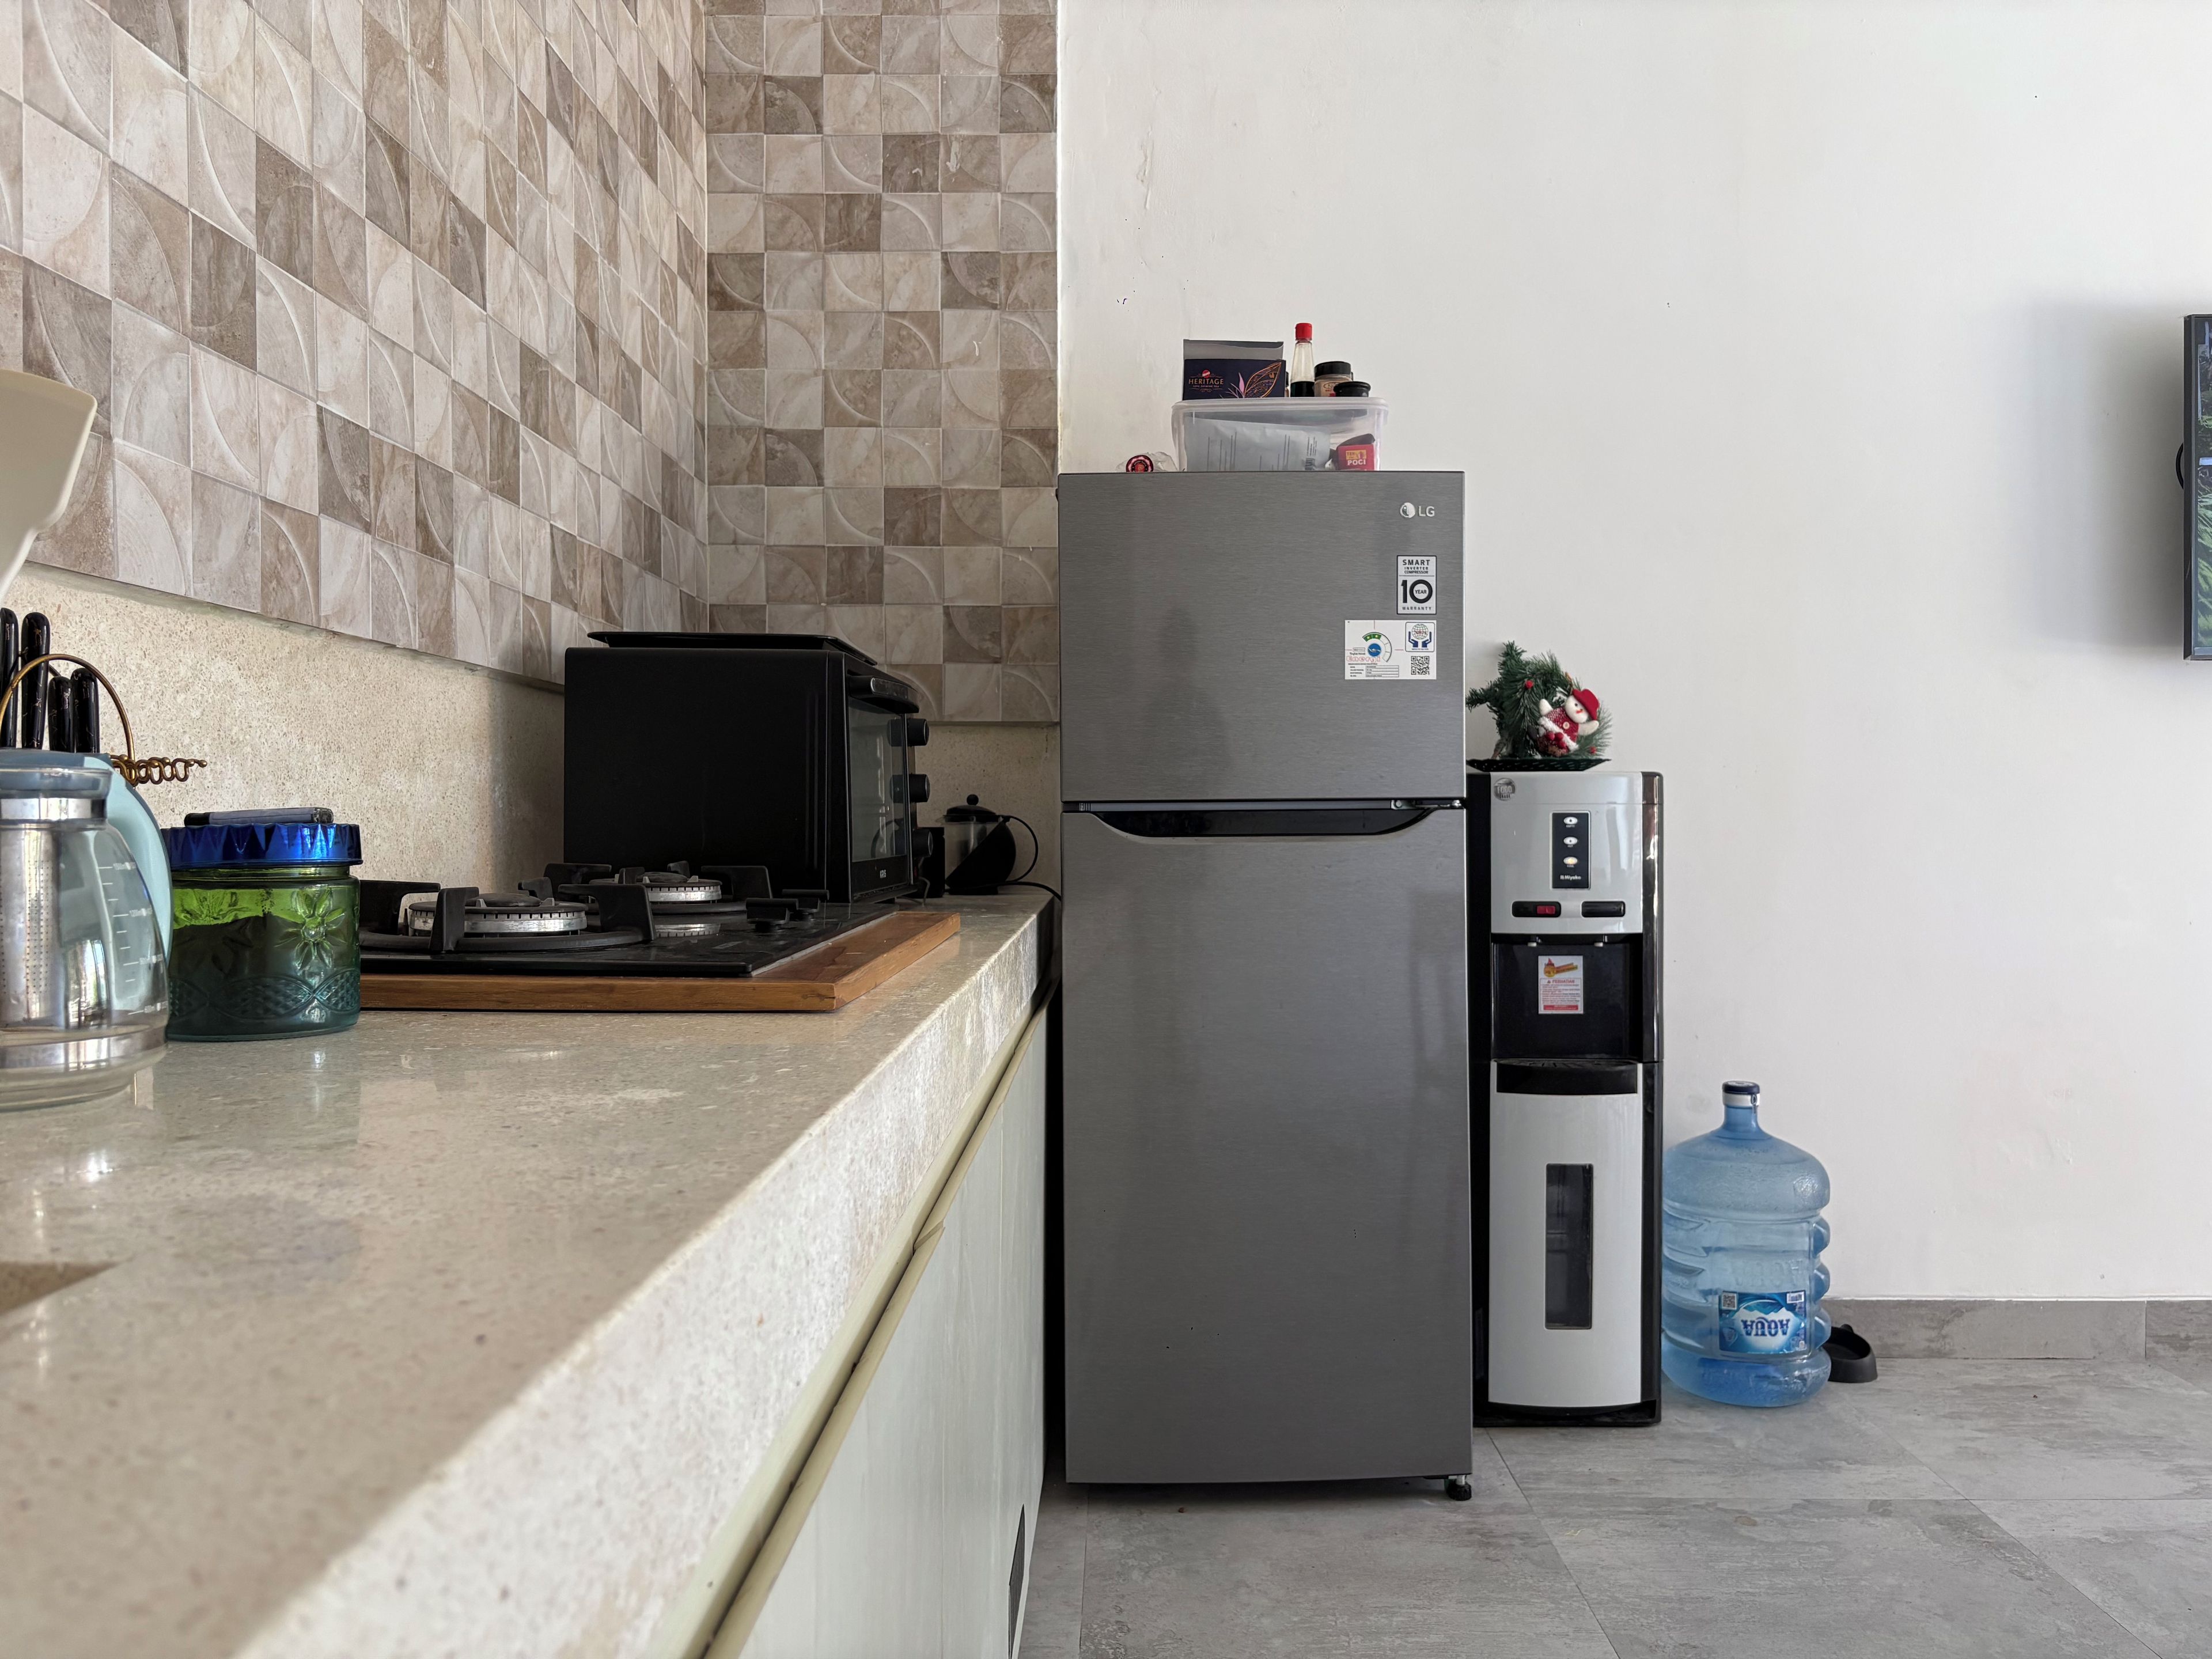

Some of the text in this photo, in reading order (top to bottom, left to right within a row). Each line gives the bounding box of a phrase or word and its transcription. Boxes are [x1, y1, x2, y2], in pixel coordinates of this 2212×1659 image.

[1418, 506, 1435, 517] LG
[1401, 579, 1433, 604] 10
[1740, 1317, 1790, 1336] AQUA
